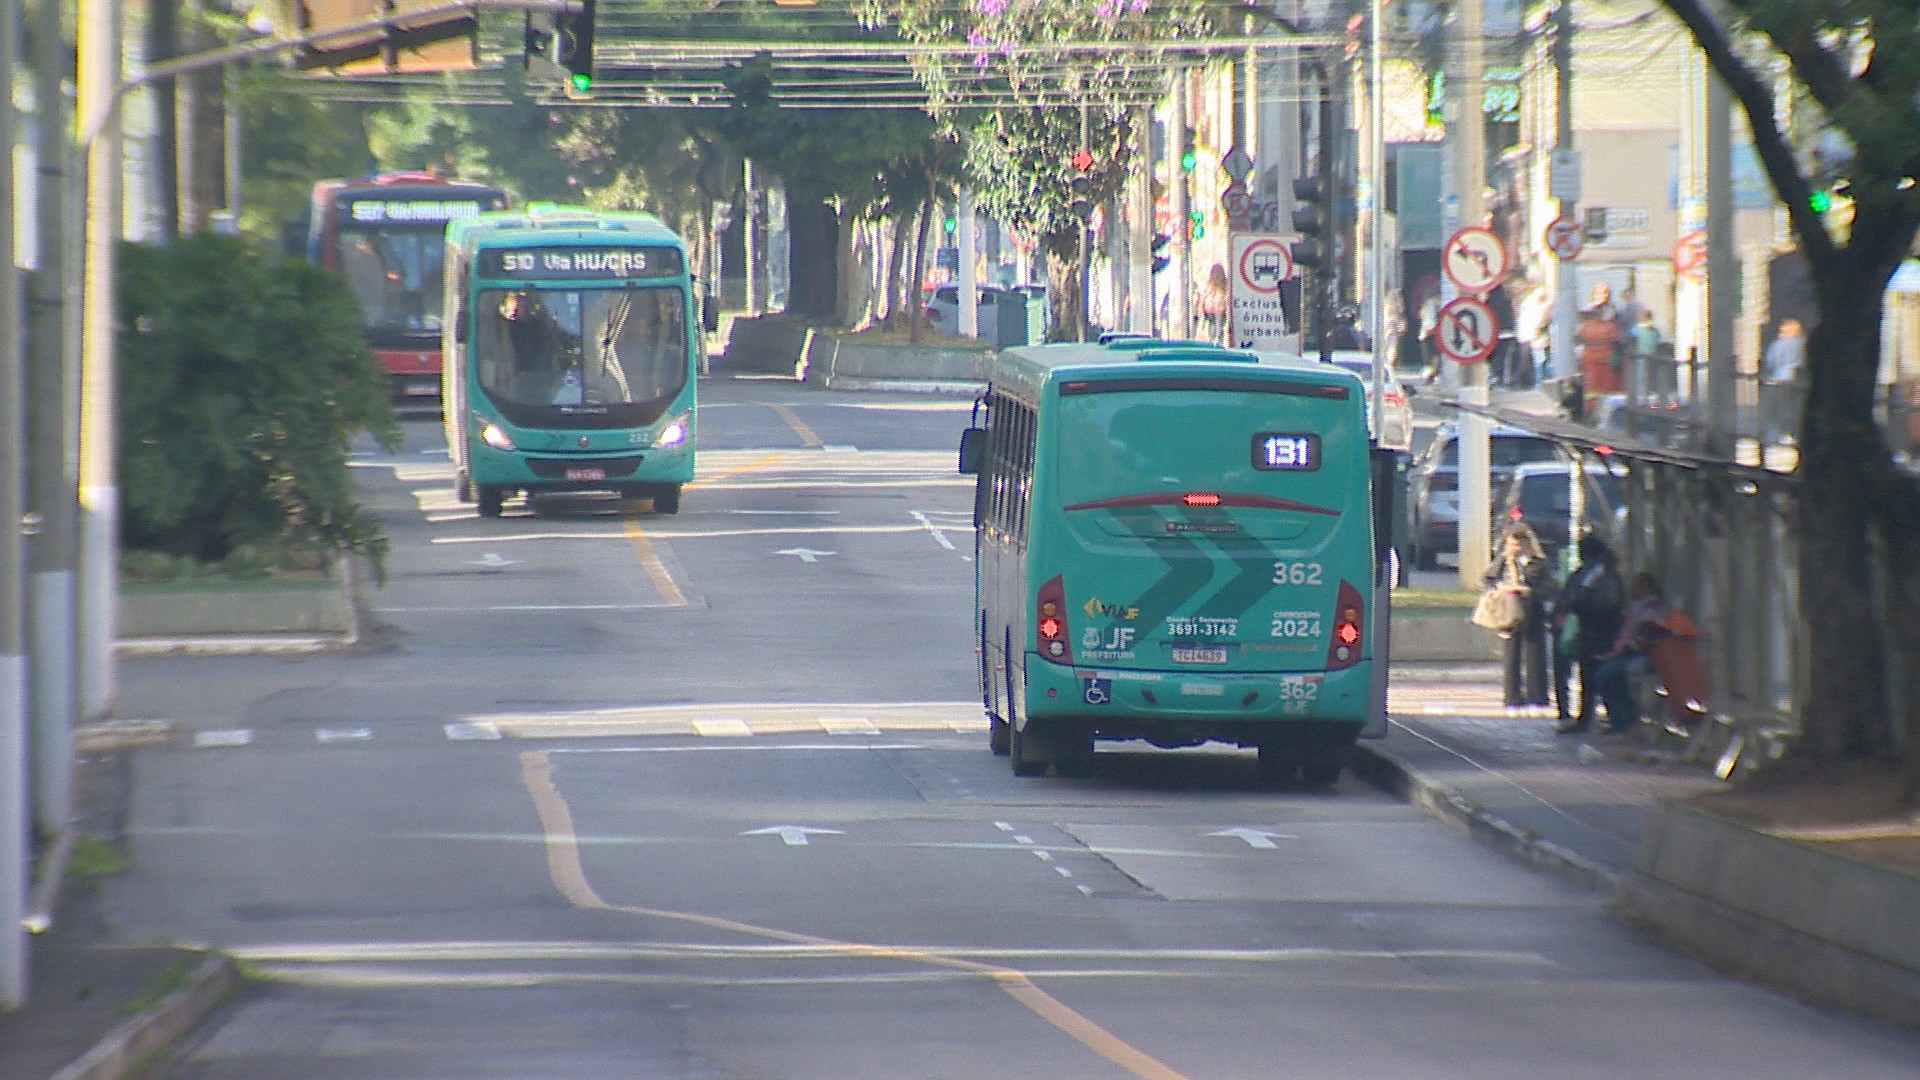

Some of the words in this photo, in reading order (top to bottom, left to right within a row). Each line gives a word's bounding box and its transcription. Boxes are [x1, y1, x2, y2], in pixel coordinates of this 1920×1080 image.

[543, 253, 571, 270] Via
[1233, 299, 1278, 309] Exclus
[1243, 312, 1281, 322] ônibu
[1263, 436, 1310, 466] 131
[1271, 562, 1323, 586] 362
[1167, 623, 1237, 636] 3691-3142
[1271, 620, 1322, 637] 2024
[1105, 627, 1136, 649] JF
[1279, 681, 1317, 701] 362
